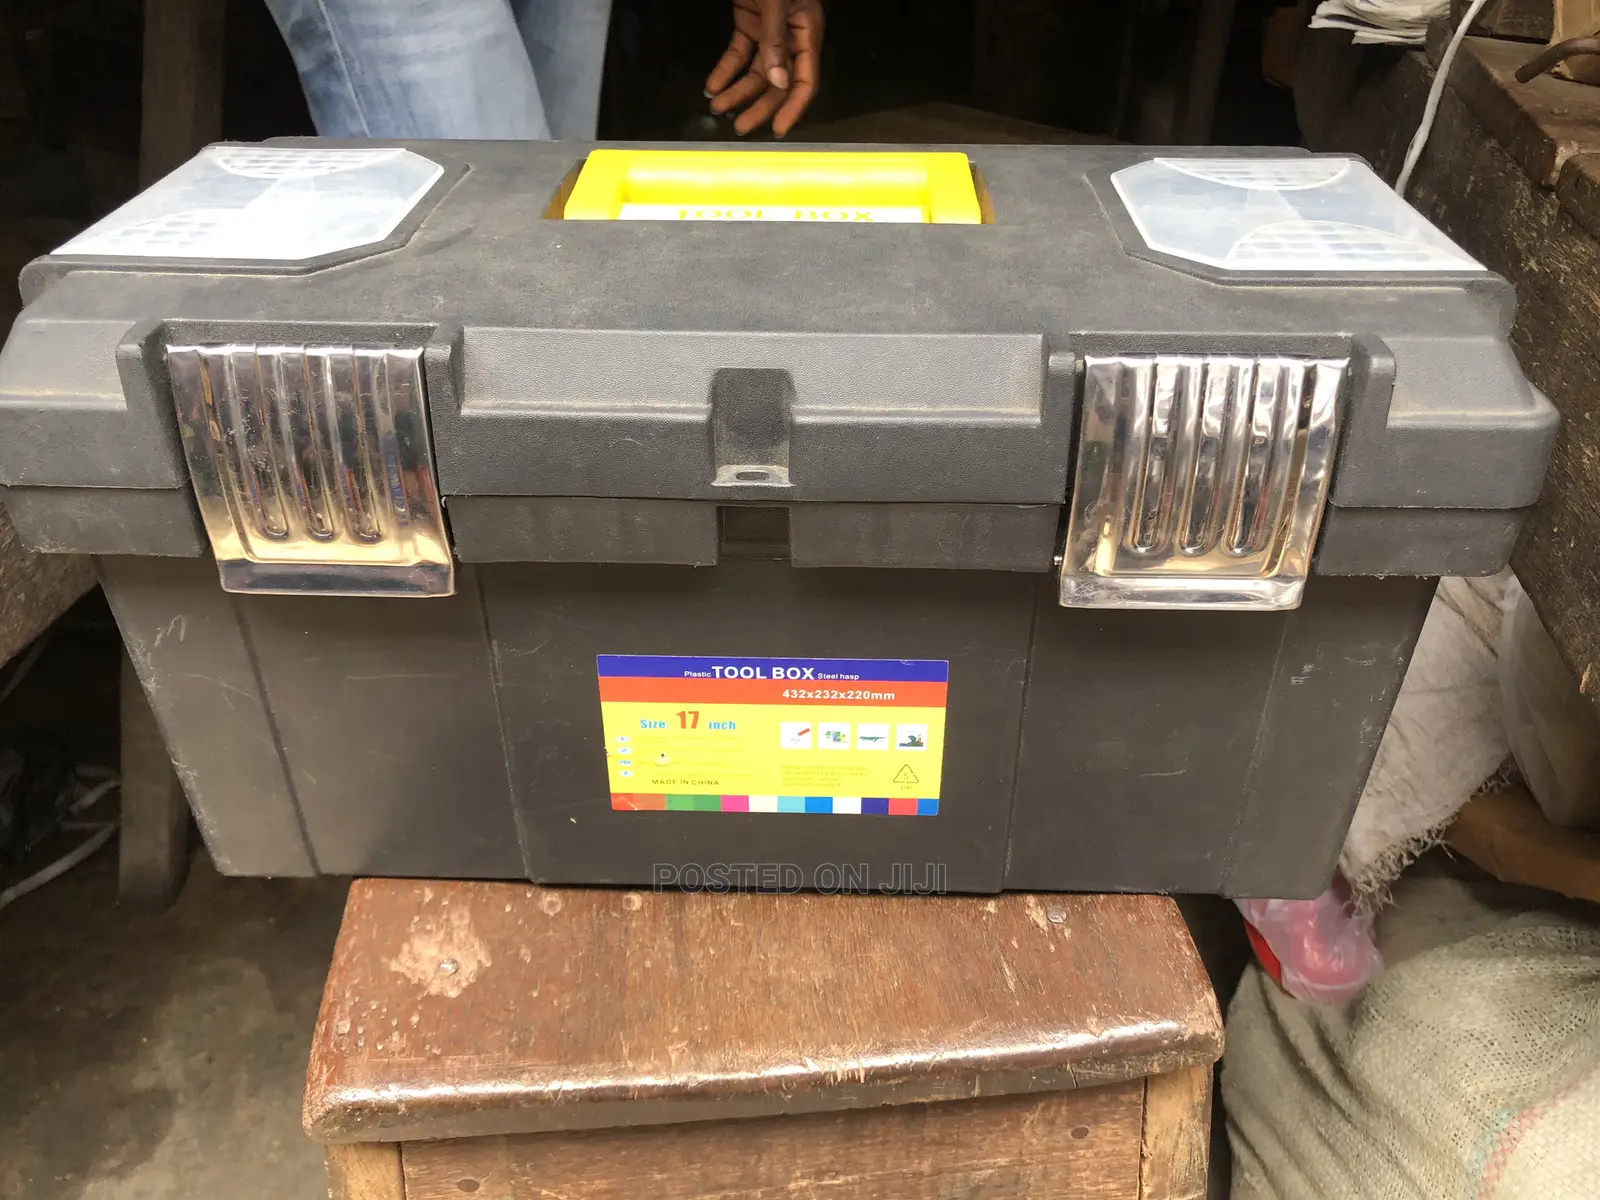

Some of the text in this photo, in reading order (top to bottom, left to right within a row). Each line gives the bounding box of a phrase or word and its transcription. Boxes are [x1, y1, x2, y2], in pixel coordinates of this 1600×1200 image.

[675, 209, 874, 222] TOOL BOX
[684, 665, 860, 682] Plastic TOOL BOX Steel hasp
[782, 688, 896, 701] 432x232x220mm
[676, 710, 700, 729] 17
[708, 720, 737, 730] inch
[691, 779, 720, 787] CHINA
